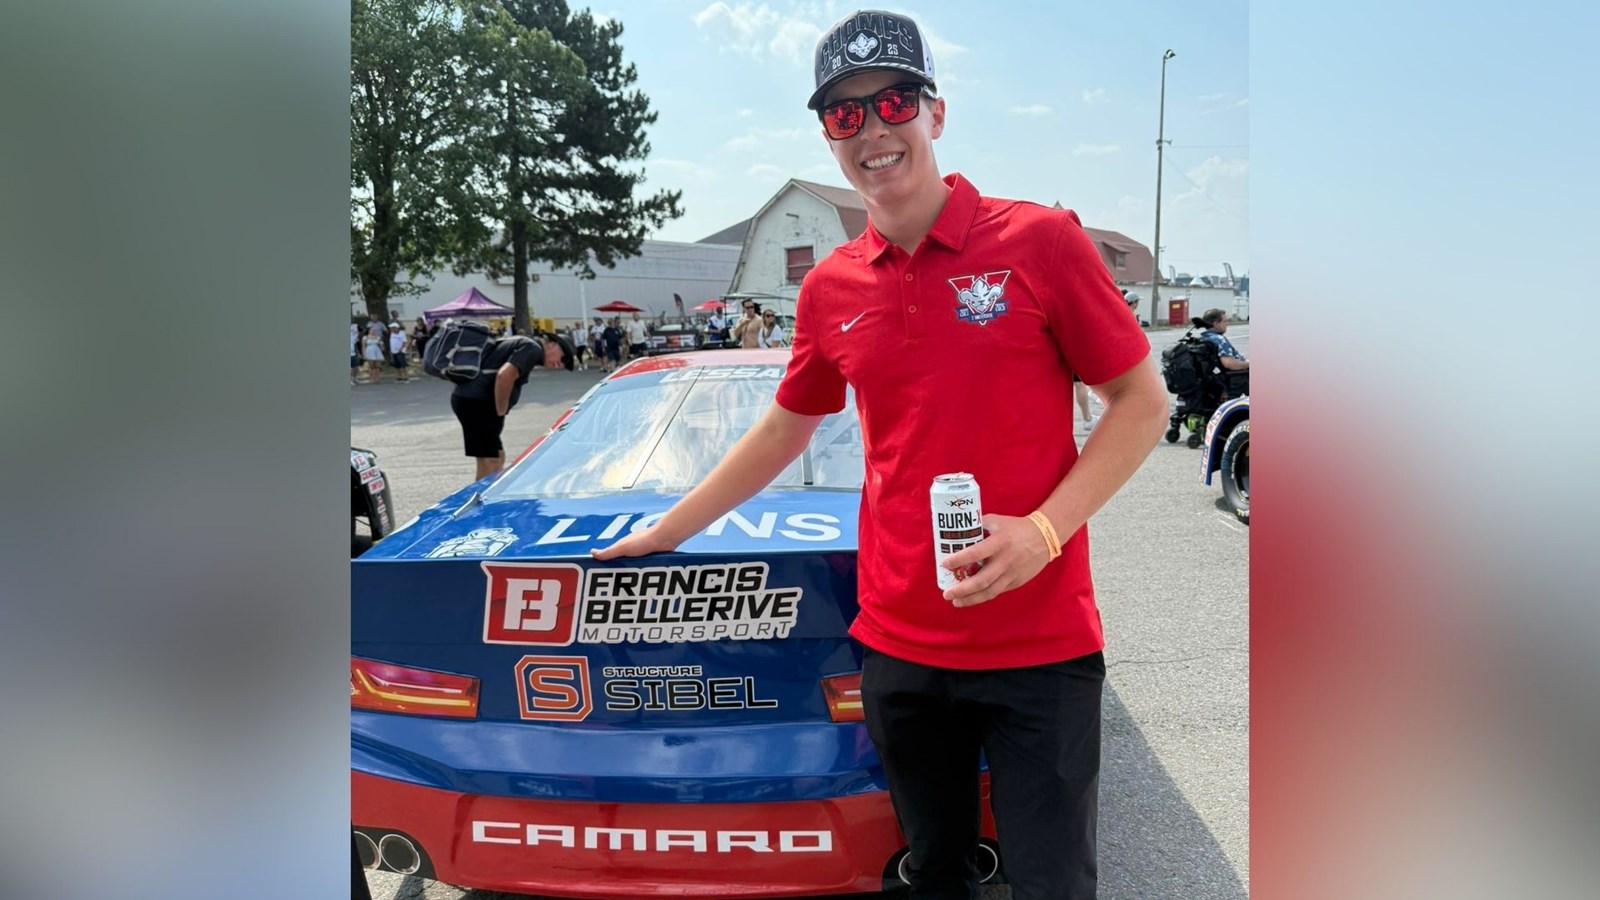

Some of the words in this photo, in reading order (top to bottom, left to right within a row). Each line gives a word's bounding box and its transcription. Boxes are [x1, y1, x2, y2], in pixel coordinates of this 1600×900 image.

[821, 13, 914, 74] CHAMPS
[887, 43, 899, 56] 25
[831, 55, 842, 70] 20
[659, 367, 785, 383] LESSA
[938, 510, 981, 529] BURN-X
[588, 566, 765, 597] FRANCIS
[585, 591, 799, 624] BELLERIVE
[582, 620, 792, 641] MOTORSPORT
[603, 665, 702, 678] STRUCTURE
[604, 676, 778, 711] SIBEL
[472, 821, 832, 853] CAMARO
